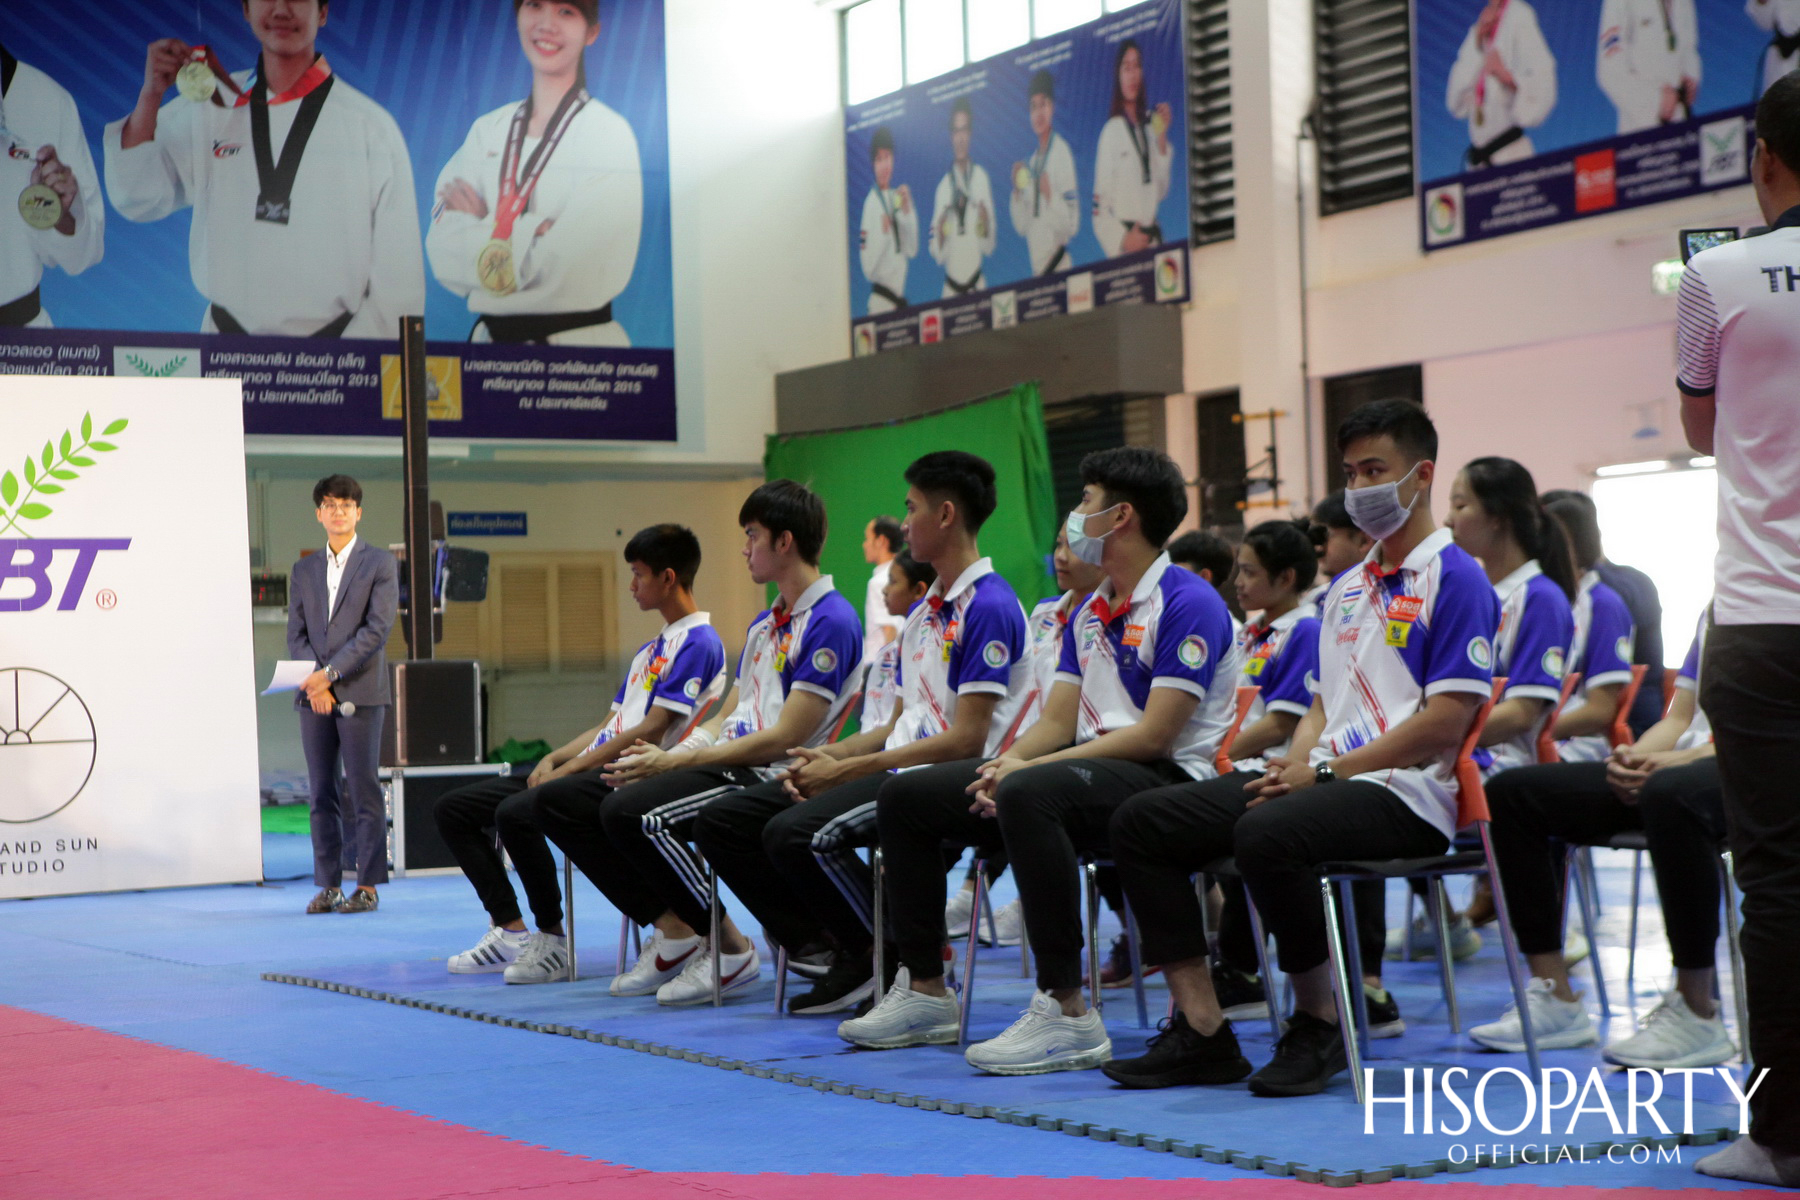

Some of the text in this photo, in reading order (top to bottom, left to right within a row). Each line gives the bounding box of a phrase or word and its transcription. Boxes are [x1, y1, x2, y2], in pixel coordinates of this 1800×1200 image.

[1760, 265, 1800, 293] TH
[77, 365, 108, 376] 2011
[347, 373, 379, 388] 2013
[0, 837, 98, 856] AND SUN
